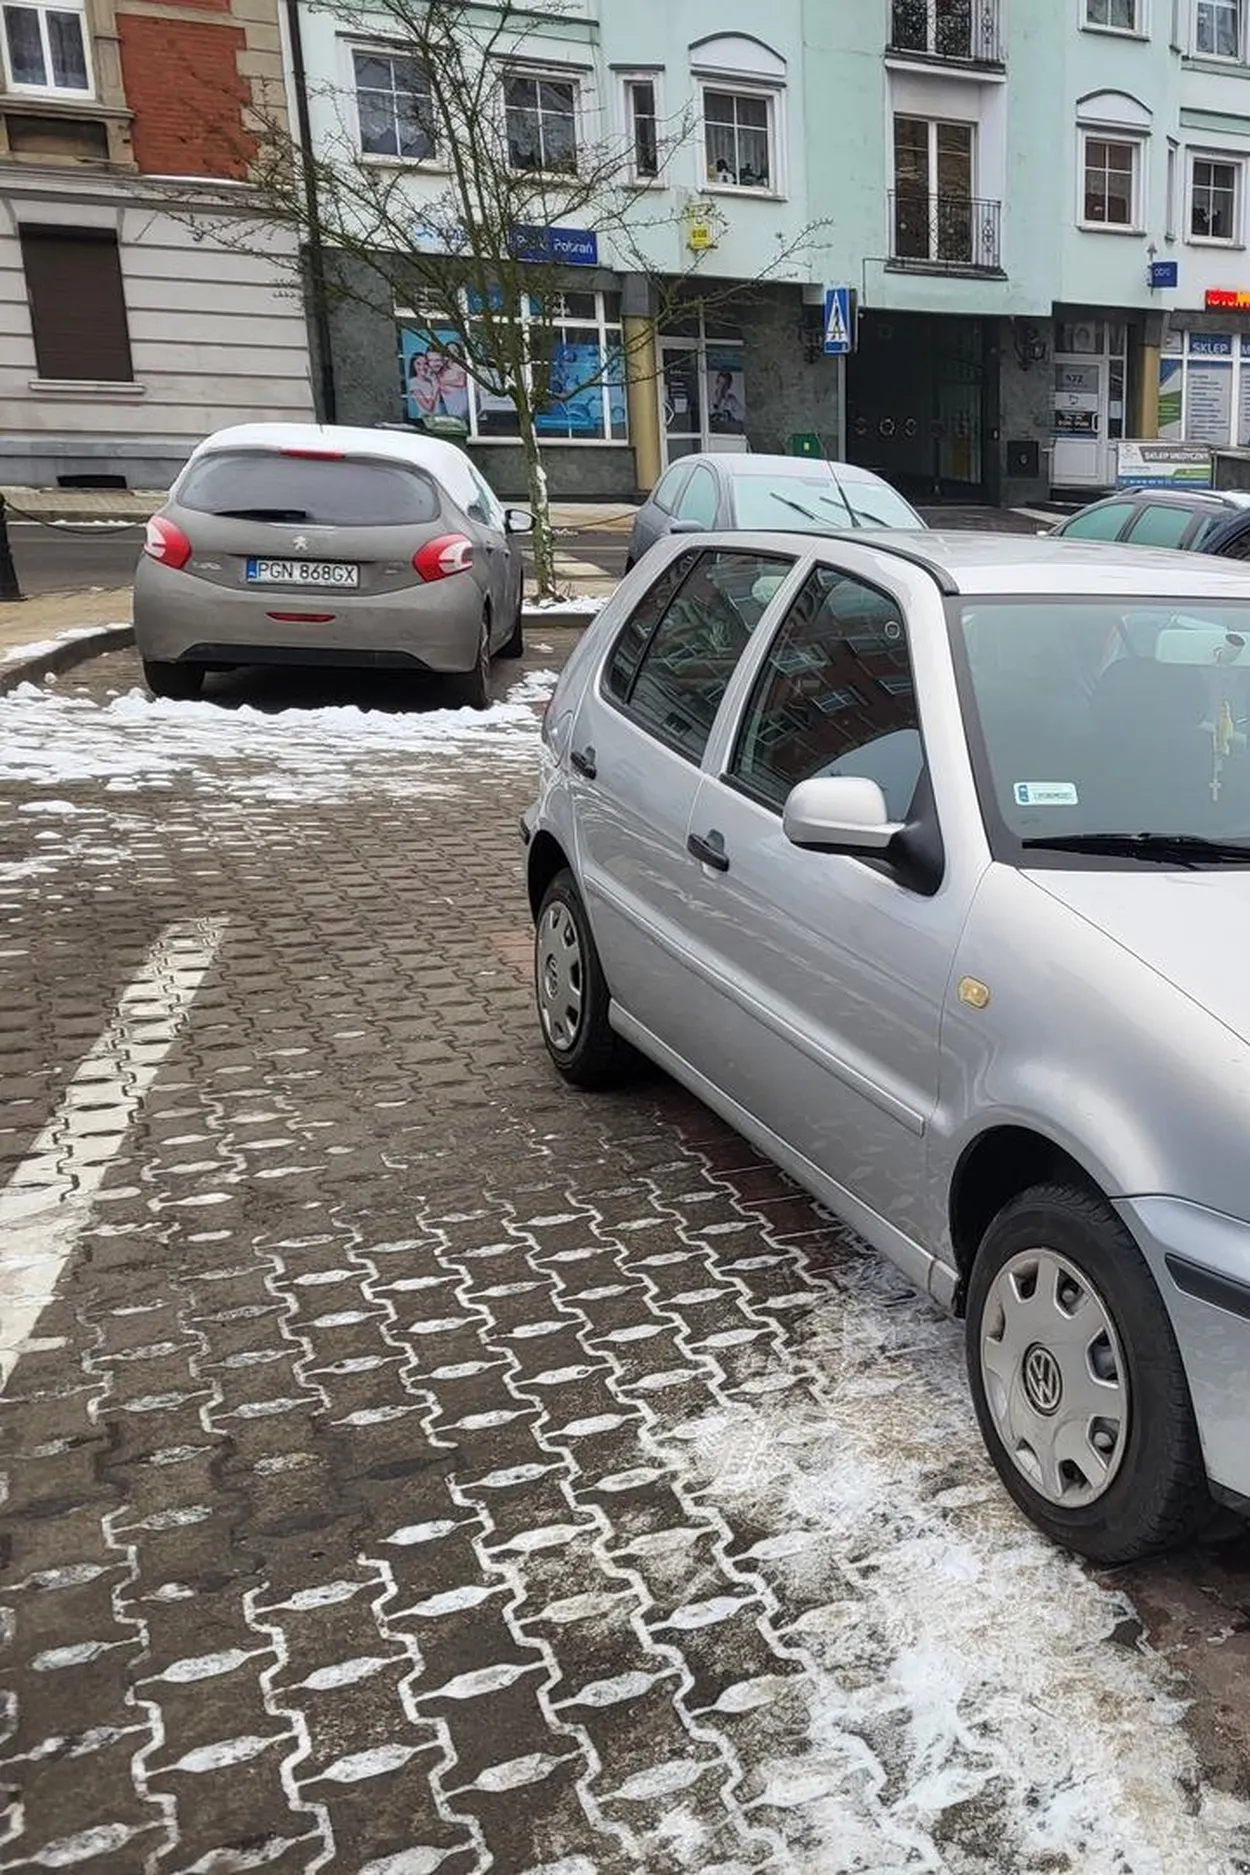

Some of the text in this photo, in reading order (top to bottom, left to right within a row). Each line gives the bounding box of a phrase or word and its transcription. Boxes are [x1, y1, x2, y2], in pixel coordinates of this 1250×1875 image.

[1192, 342, 1228, 354] SKLEP
[258, 562, 356, 582] PGN 868GX
